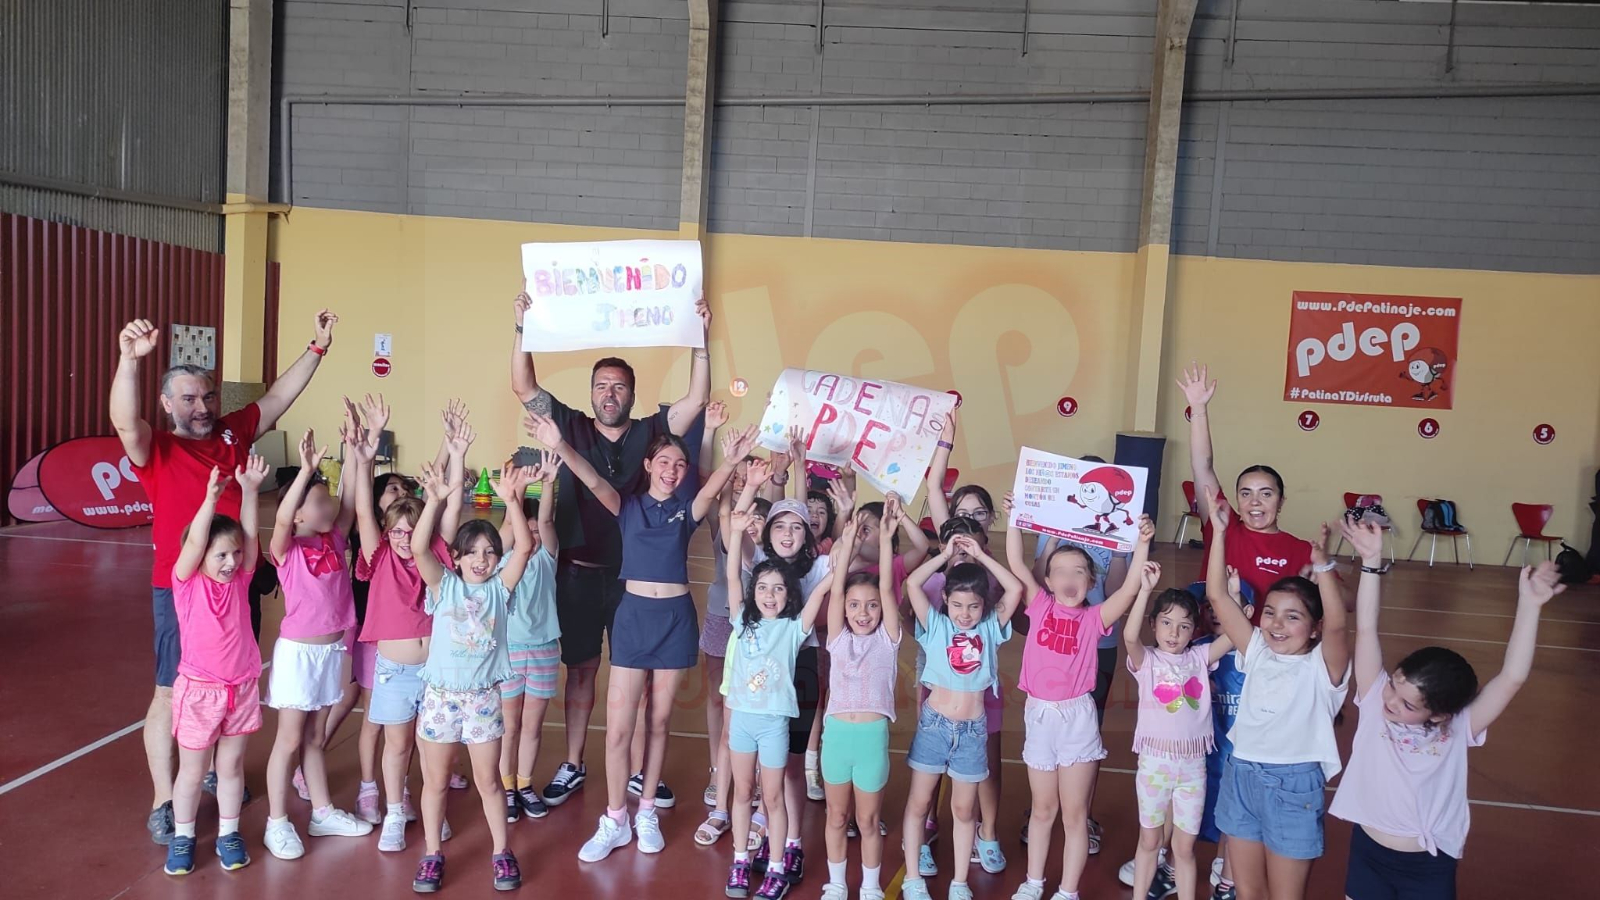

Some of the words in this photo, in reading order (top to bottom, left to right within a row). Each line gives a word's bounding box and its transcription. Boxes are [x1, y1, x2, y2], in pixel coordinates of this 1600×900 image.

[1296, 300, 1457, 318] www.PdePatinaje.com
[1296, 321, 1421, 378] pdep
[733, 380, 745, 392] 12
[1290, 387, 1393, 404] #PatinaYDisfruta
[1063, 401, 1072, 411] 9
[1305, 414, 1313, 425] 7
[1424, 422, 1433, 433] 6
[1540, 427, 1548, 438] 5
[1256, 556, 1288, 567] pdep
